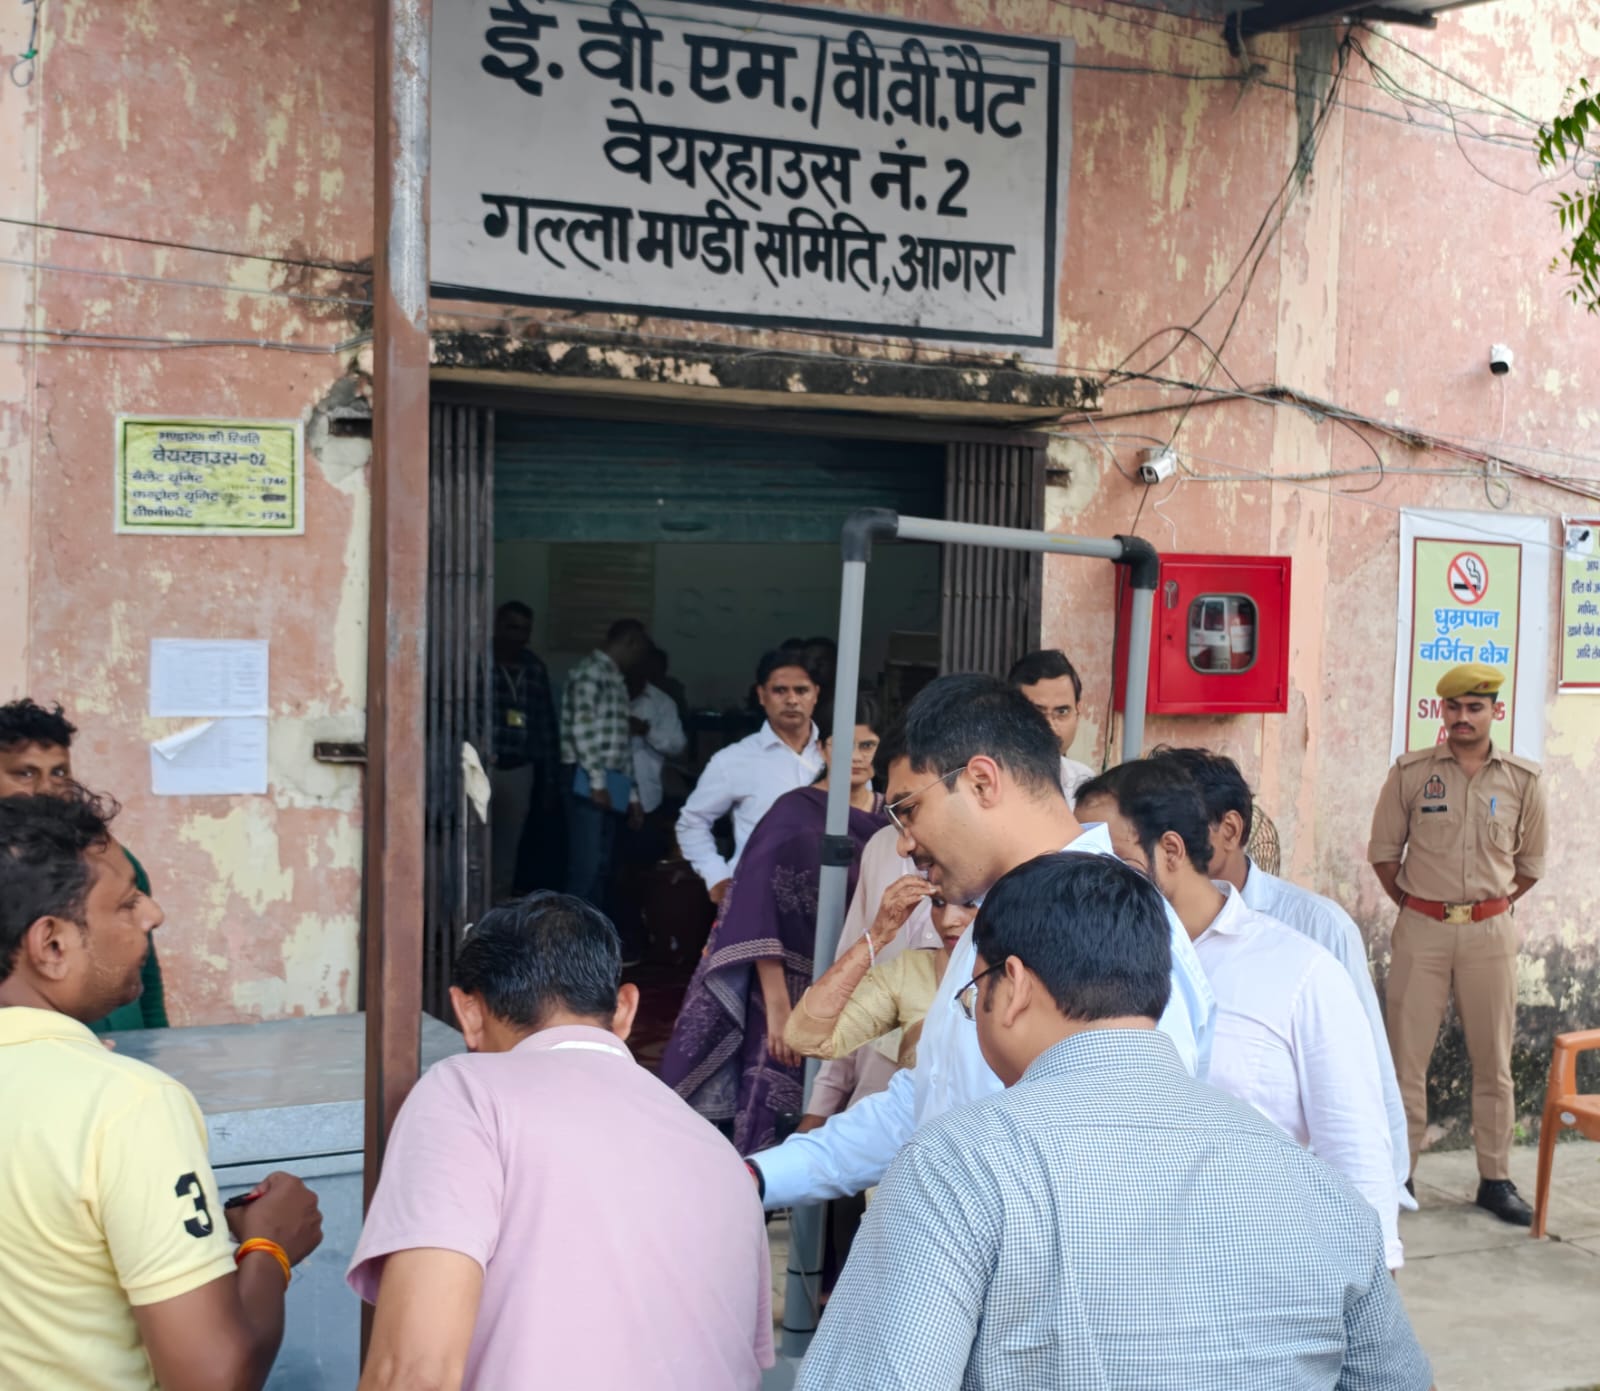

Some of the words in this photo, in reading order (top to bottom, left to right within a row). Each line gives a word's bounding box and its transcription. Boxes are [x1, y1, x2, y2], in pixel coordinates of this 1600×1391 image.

[603, 99, 861, 211] वेयरहाउस
[481, 193, 634, 272] गल्ला
[637, 199, 750, 275] मण्डी
[1419, 637, 1475, 662] वर्जित
[1479, 640, 1510, 664] क्षेत्र
[174, 1171, 214, 1239] 3
